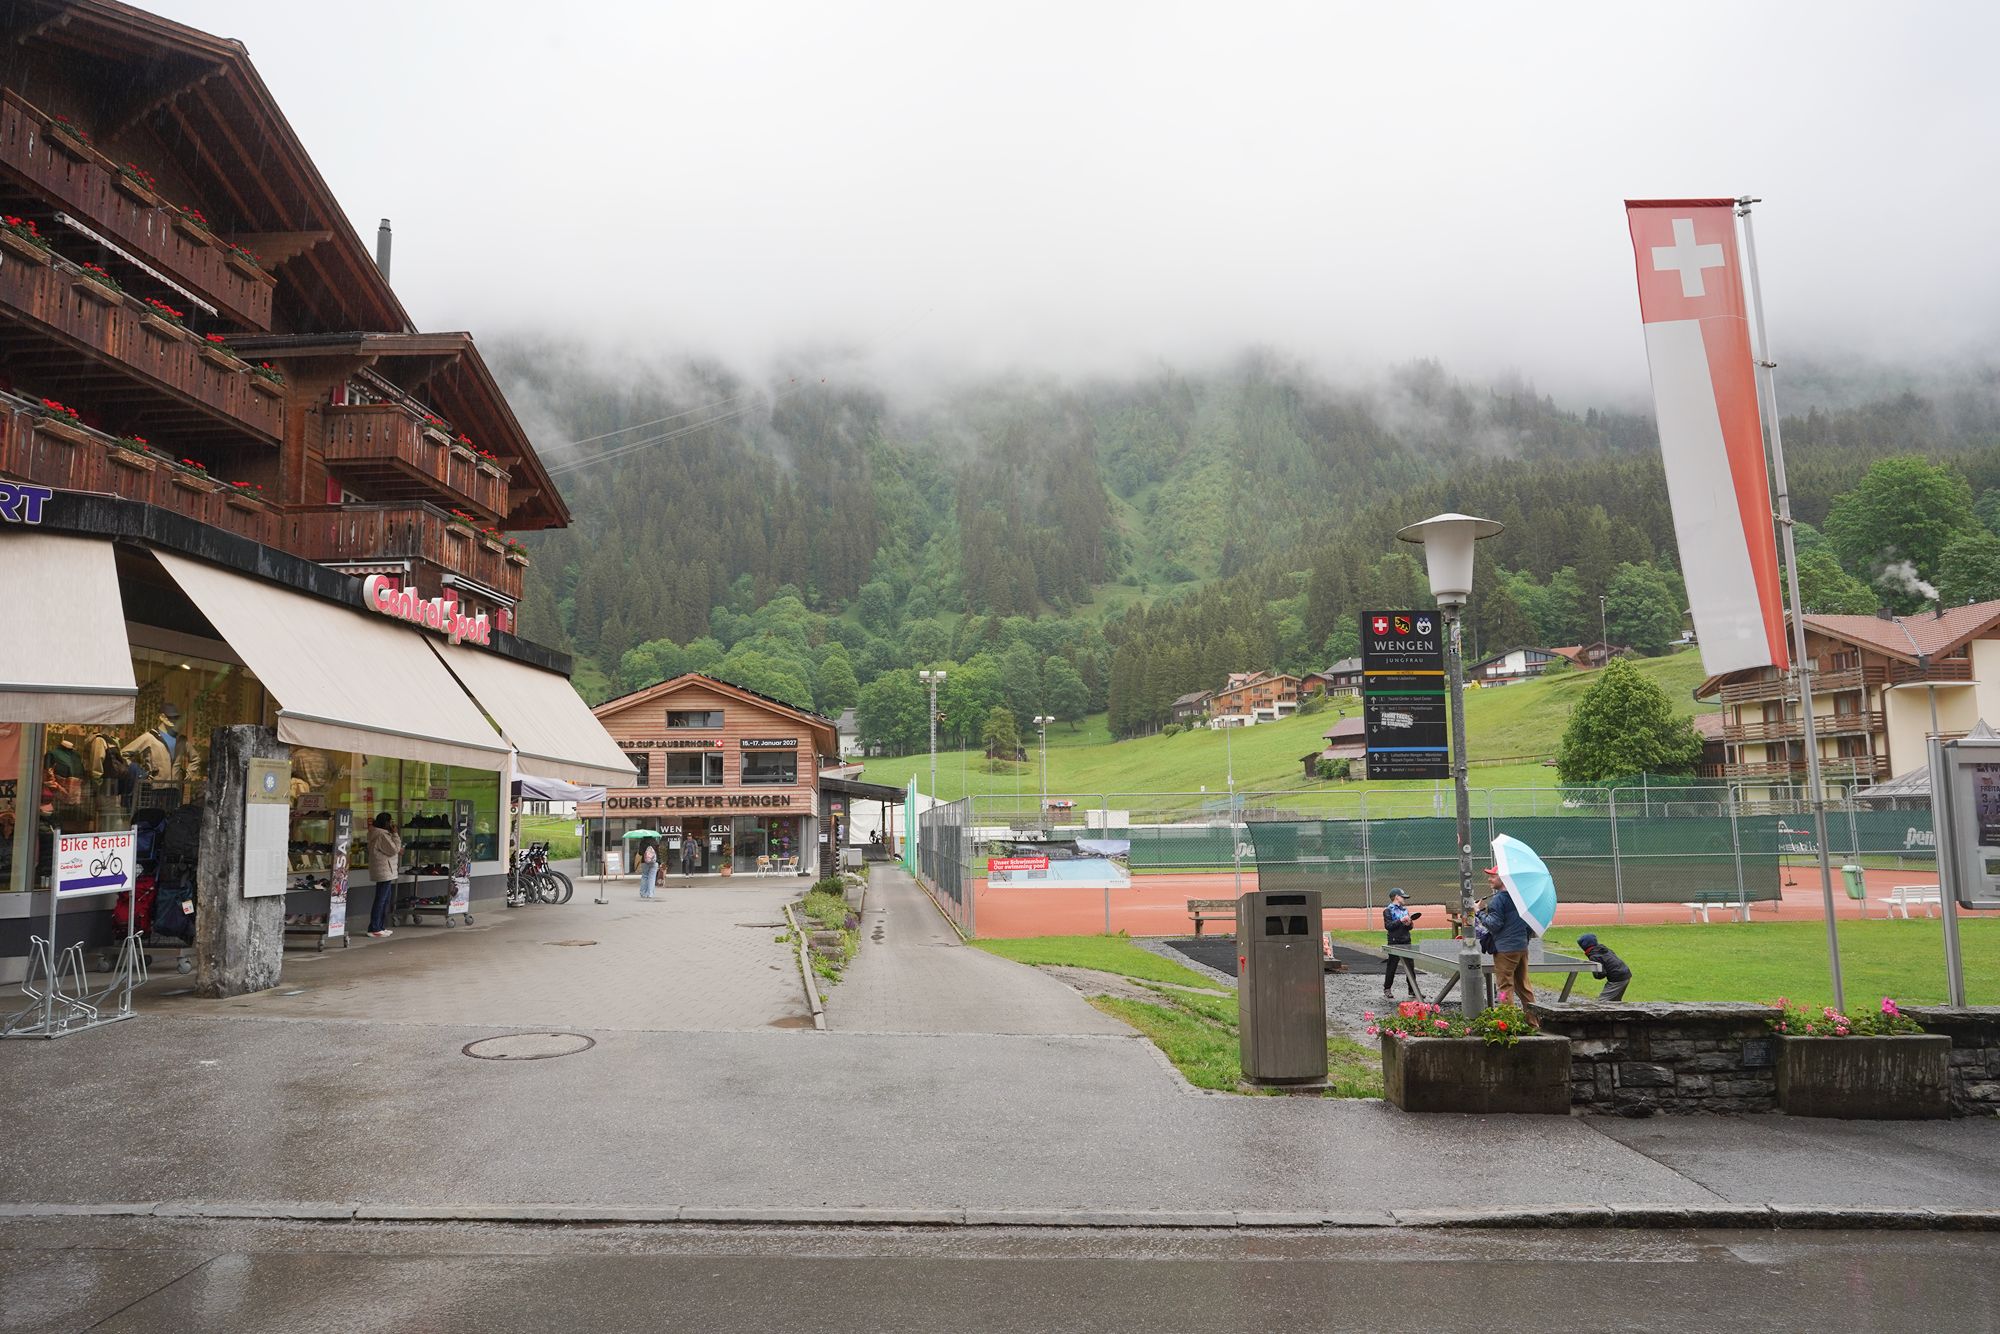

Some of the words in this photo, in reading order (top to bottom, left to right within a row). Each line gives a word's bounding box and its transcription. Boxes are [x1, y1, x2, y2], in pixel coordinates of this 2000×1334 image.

[369, 575, 444, 629] Central
[446, 600, 491, 645] Sport
[1374, 641, 1433, 651] WENGEN
[637, 740, 654, 749] CUP
[656, 740, 715, 749] LAUBERHORN
[602, 797, 661, 809] OURIST
[665, 796, 723, 808] CENTER
[724, 795, 791, 808] WENGEN
[458, 804, 469, 853] SALE
[660, 825, 682, 833] WEN
[711, 824, 730, 832] GEN
[61, 837, 88, 852] Bike
[92, 833, 131, 849] Rental
[336, 814, 350, 868] SALE
